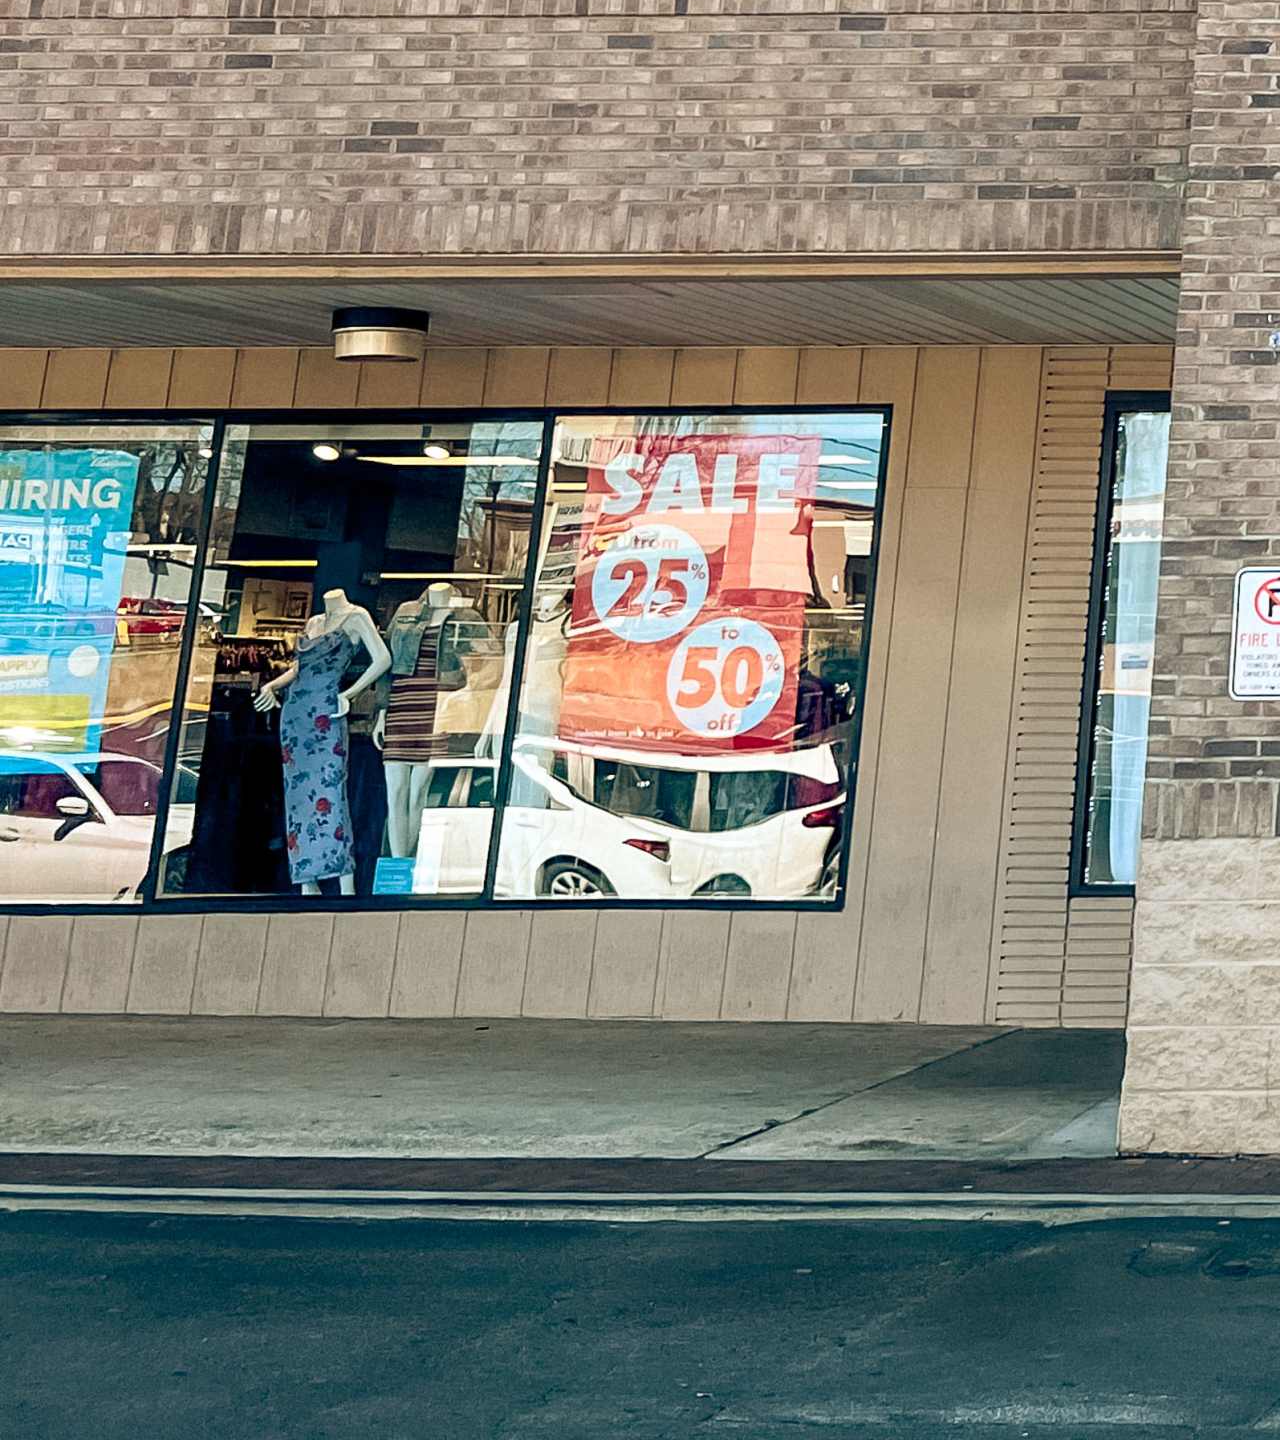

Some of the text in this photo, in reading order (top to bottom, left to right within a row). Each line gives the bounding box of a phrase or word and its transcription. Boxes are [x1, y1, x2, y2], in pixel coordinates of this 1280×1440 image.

[601, 453, 800, 515] SALE
[721, 626, 741, 641] to
[1240, 632, 1269, 647] FIRE
[707, 713, 736, 731] off
